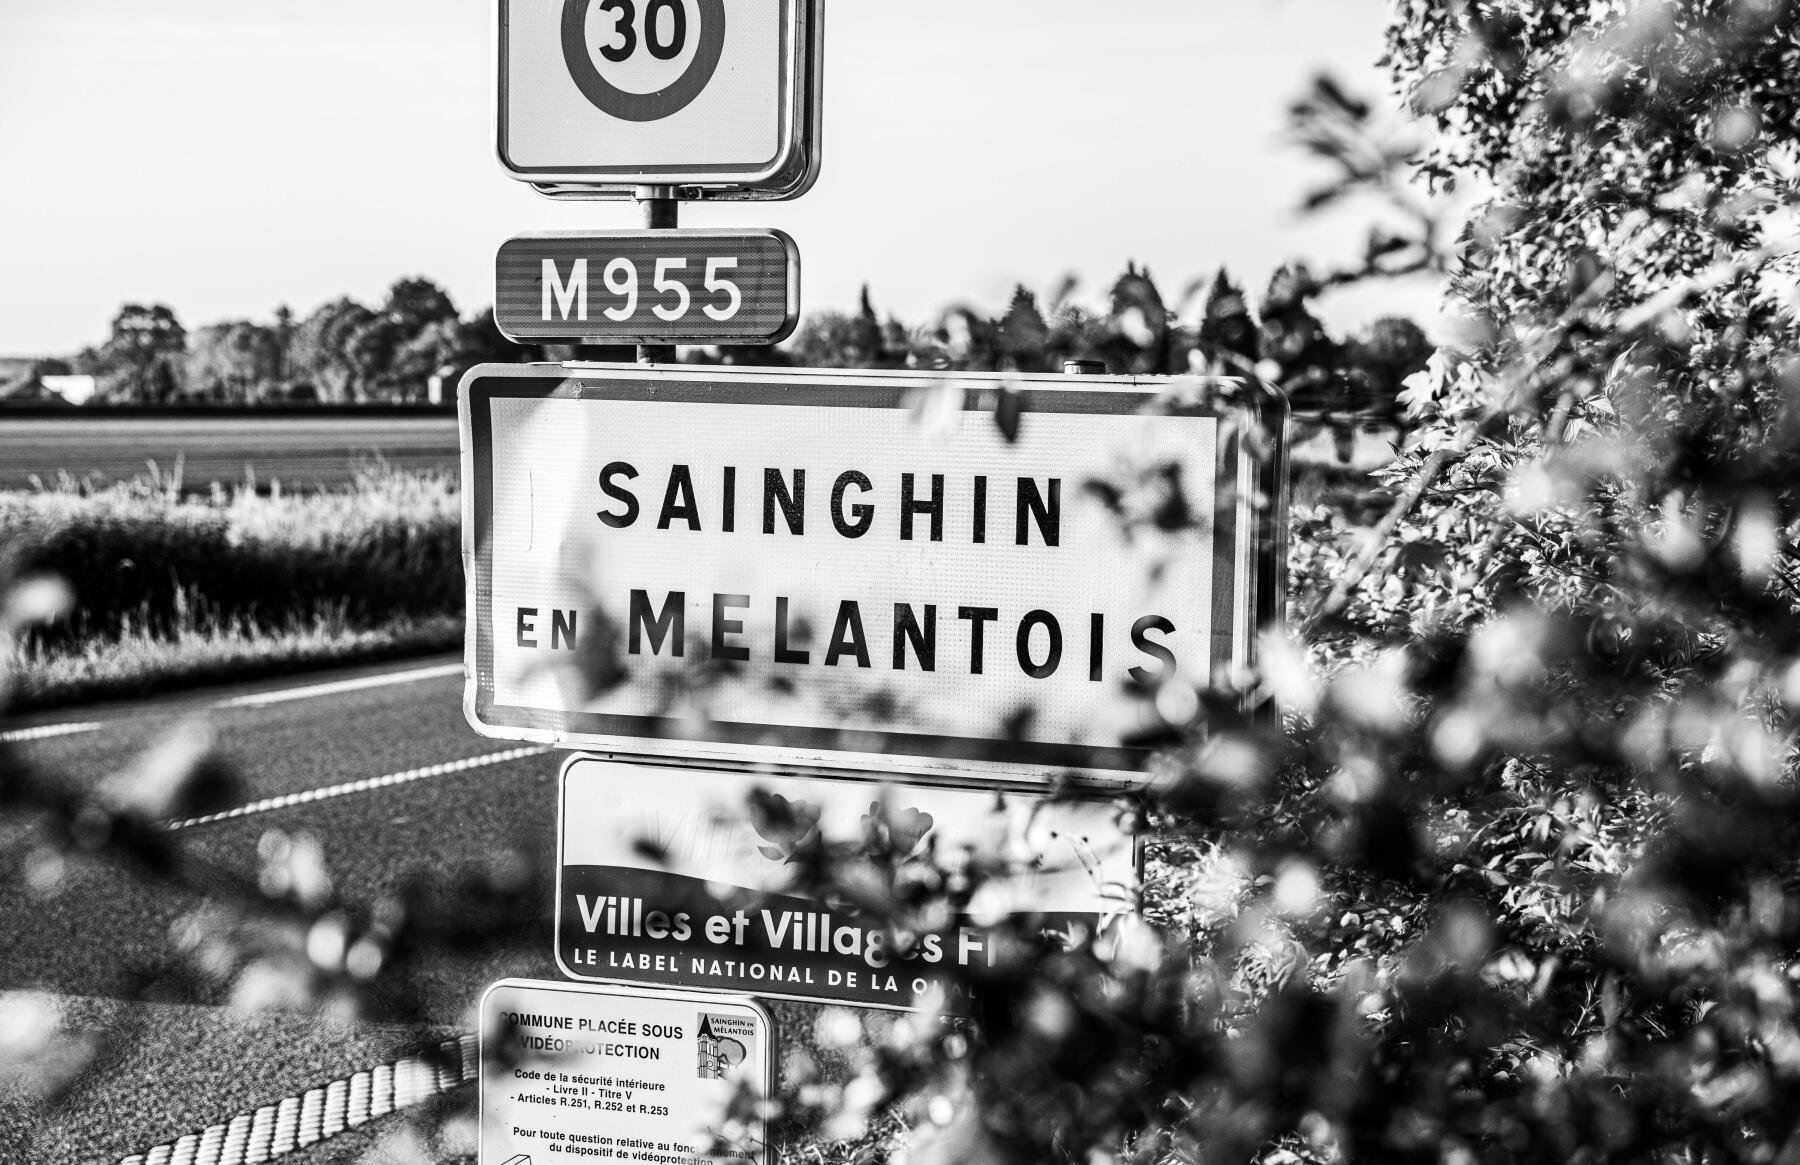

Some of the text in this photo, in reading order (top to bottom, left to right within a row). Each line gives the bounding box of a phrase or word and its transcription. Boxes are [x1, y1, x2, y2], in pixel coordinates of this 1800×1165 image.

[599, 0, 687, 62] 30
[541, 257, 742, 322] M955
[596, 461, 1062, 548] SAINGHIN
[517, 589, 1177, 684] EN MELANTOIS
[575, 894, 692, 942] Villes
[705, 909, 750, 946] et
[573, 948, 598, 966] LE
[609, 951, 679, 972] LABEL
[691, 957, 815, 985] NATIONAL
[827, 969, 858, 989] DE
[871, 974, 899, 992] LA
[578, 1018, 637, 1036] PLACÉE
[642, 1023, 684, 1040] SOUS
[710, 1017, 746, 1027] SAINGHIN
[714, 1025, 754, 1036] MÉLANTOIS
[514, 1068, 665, 1092] Code de la sécurité intérieure
[553, 1084, 579, 1097] Livre
[598, 1088, 622, 1100] Titre
[625, 1090, 633, 1101] V
[517, 1093, 557, 1106] Articles
[560, 1096, 591, 1111] R.251,
[594, 1100, 623, 1112] R.252
[626, 1103, 636, 1114] et
[639, 1104, 669, 1117] R.253
[513, 1126, 537, 1138] Pour
[540, 1129, 566, 1141] toute
[568, 1133, 613, 1146] question
[616, 1137, 655, 1150] relative
[657, 1142, 670, 1152] au
[549, 1142, 714, 1165] du dispositif de vidéoprotection
